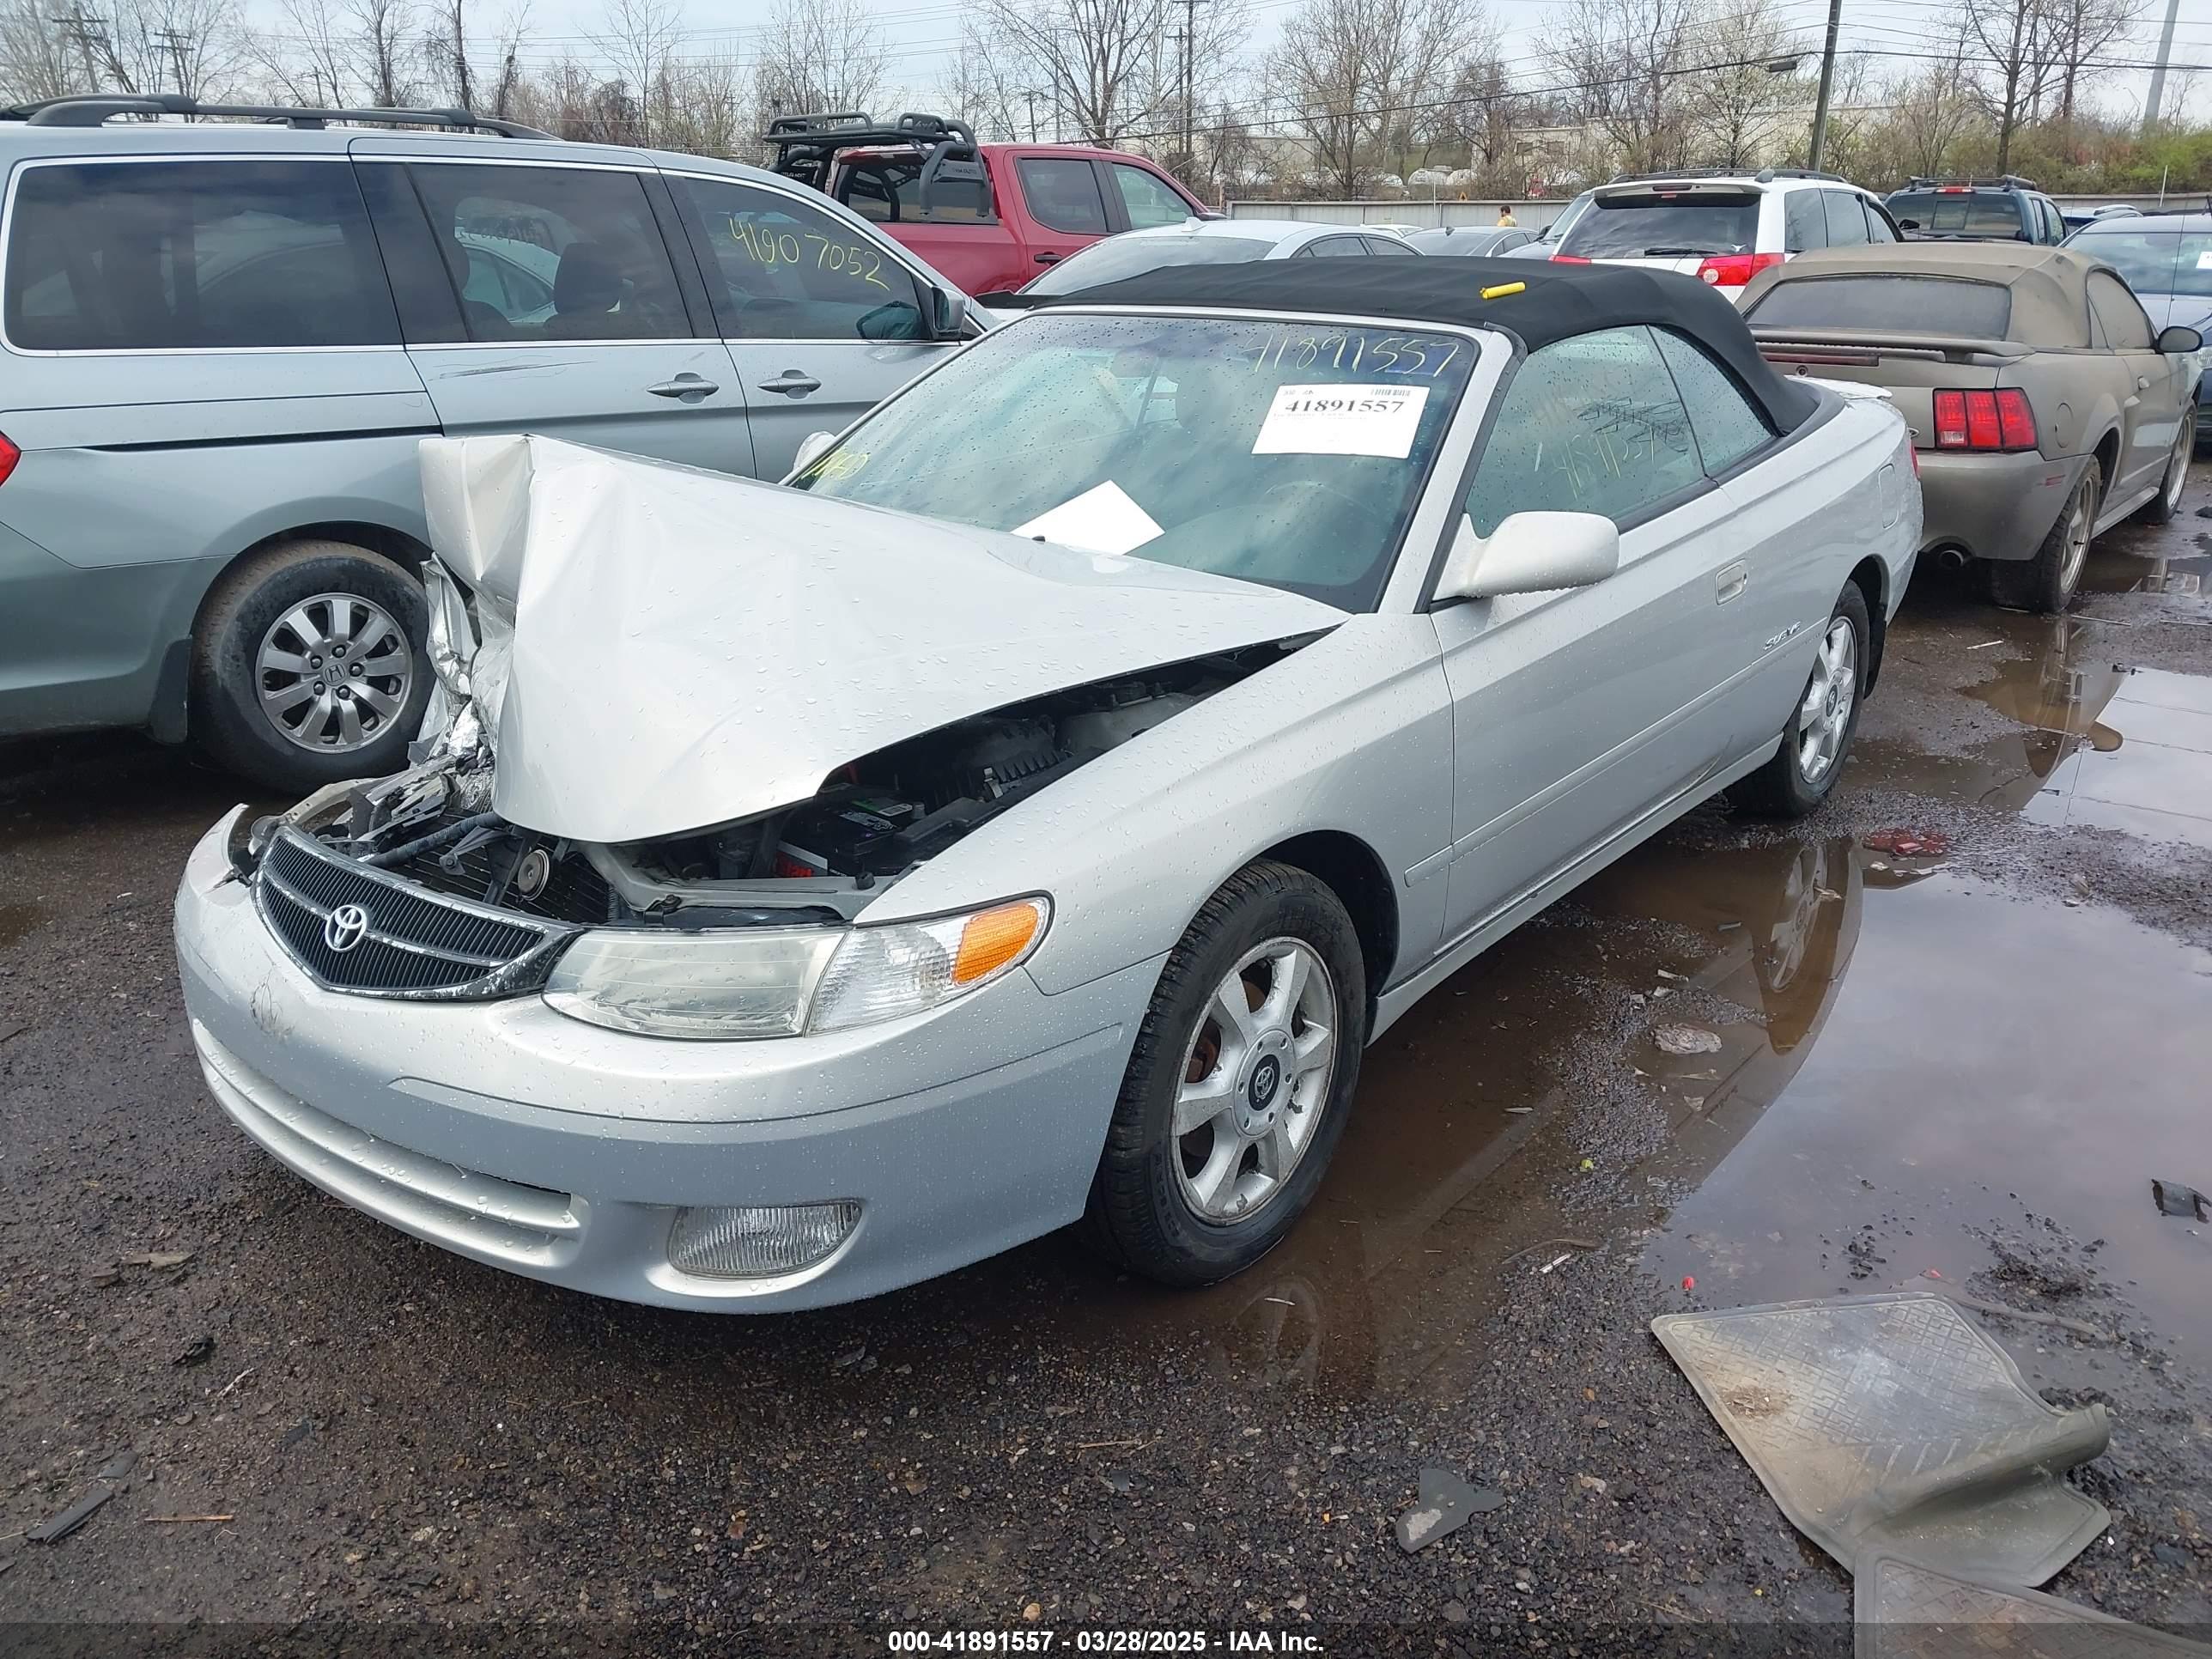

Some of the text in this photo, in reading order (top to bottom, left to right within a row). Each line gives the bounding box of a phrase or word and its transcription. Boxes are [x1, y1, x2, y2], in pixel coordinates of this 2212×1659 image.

[805, 234, 890, 291] 7052
[1245, 333, 1459, 377] 41891557
[1284, 399, 1405, 413] 41891557
